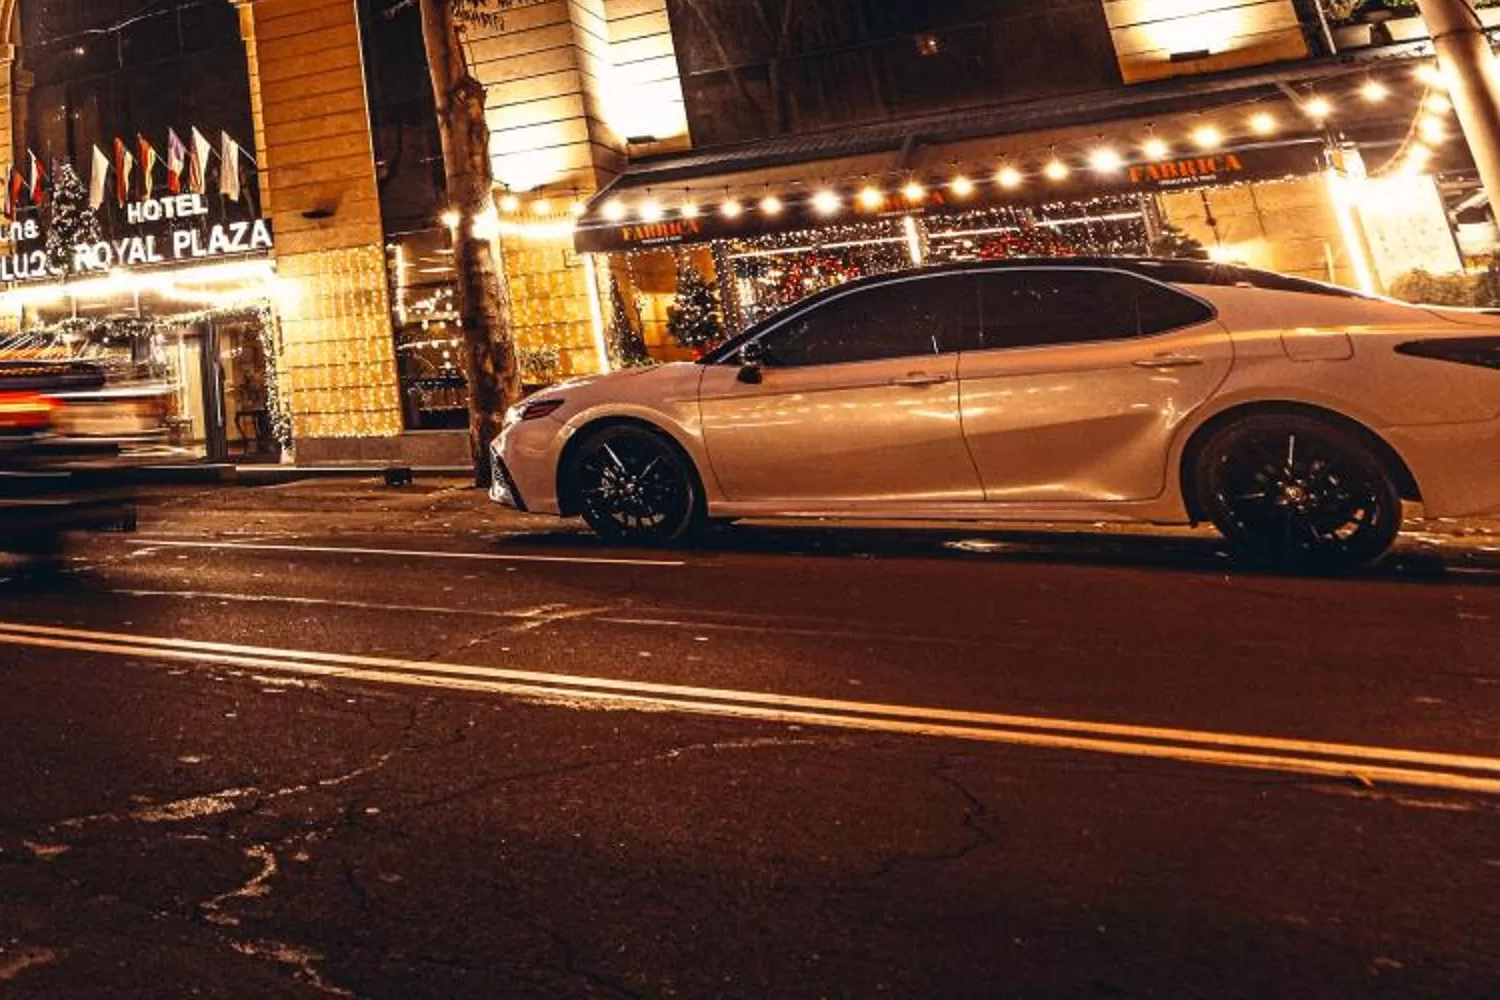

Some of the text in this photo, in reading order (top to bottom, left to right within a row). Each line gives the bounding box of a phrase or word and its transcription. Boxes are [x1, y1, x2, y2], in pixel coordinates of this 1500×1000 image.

[127, 194, 208, 224] HOTEL
[74, 219, 273, 271] ROYAL PLAZA
